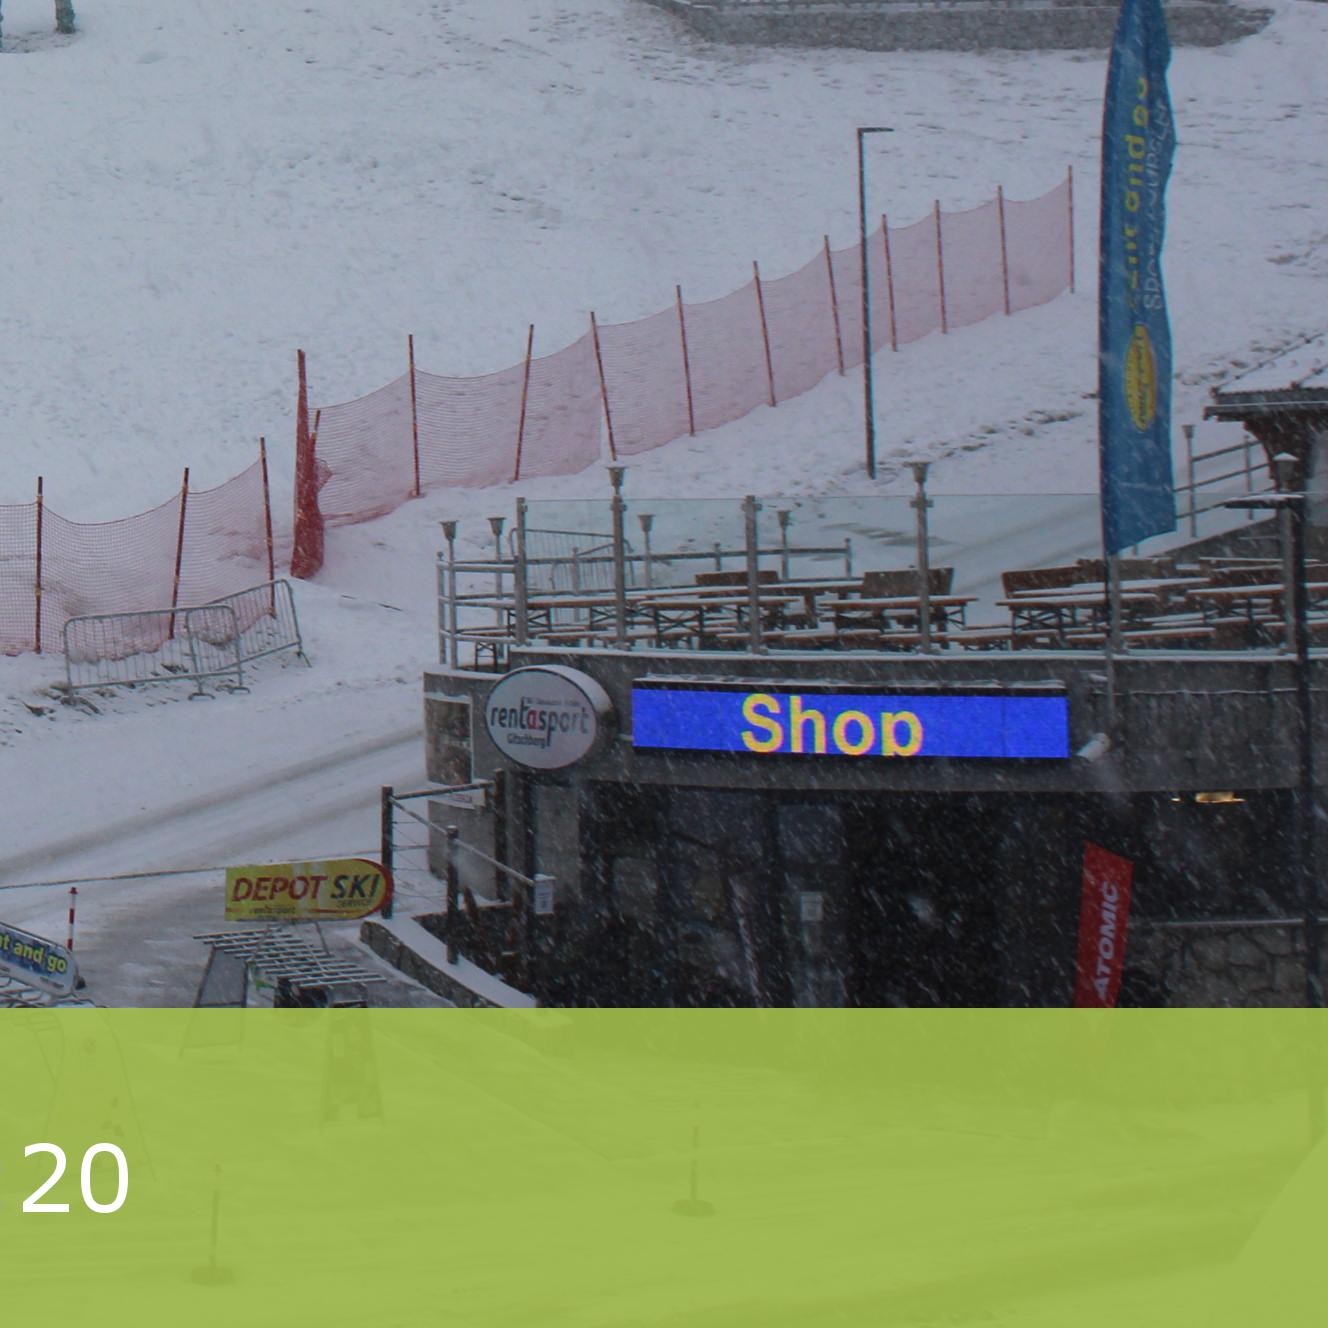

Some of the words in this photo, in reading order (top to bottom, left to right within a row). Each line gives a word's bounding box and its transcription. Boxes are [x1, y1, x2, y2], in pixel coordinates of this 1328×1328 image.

[490, 696, 589, 747] rentasport
[743, 693, 921, 756] Shop
[231, 875, 328, 902] DEPOT
[330, 873, 381, 900] SKI
[13, 941, 44, 965] and
[47, 954, 67, 973] go
[1094, 879, 1120, 1002] ATOMIC
